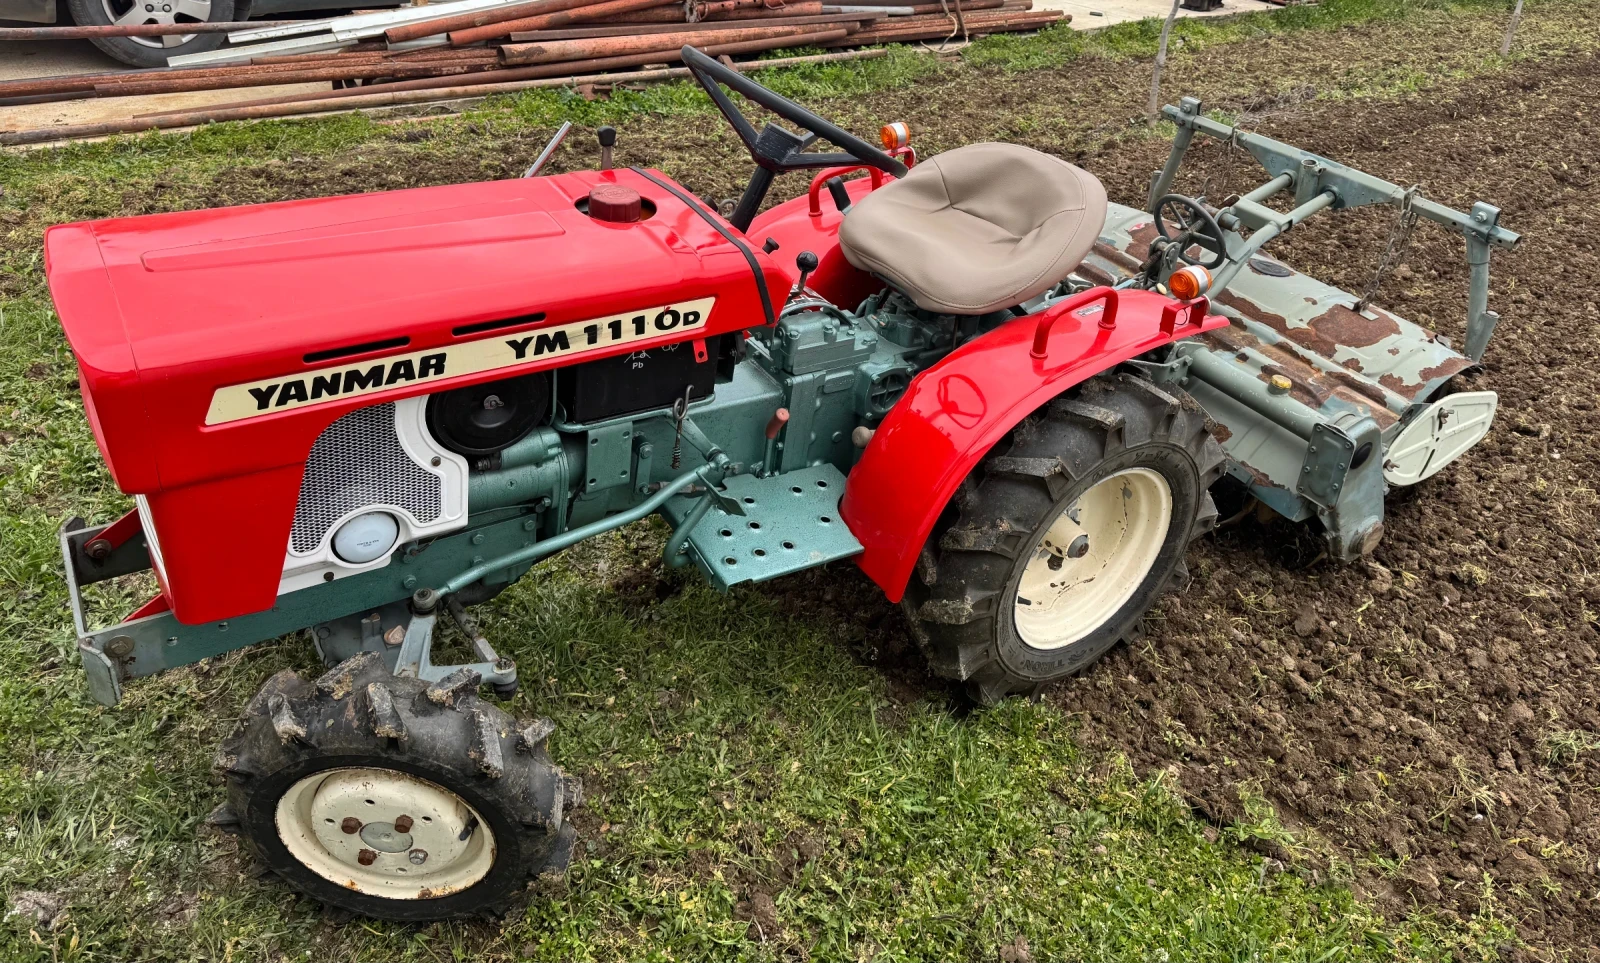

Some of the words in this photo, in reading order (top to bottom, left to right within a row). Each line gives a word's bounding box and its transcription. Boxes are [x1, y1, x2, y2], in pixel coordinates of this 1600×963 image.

[248, 352, 447, 410] YANMAR
[505, 330, 570, 360] YM
[632, 361, 644, 370] Pb
